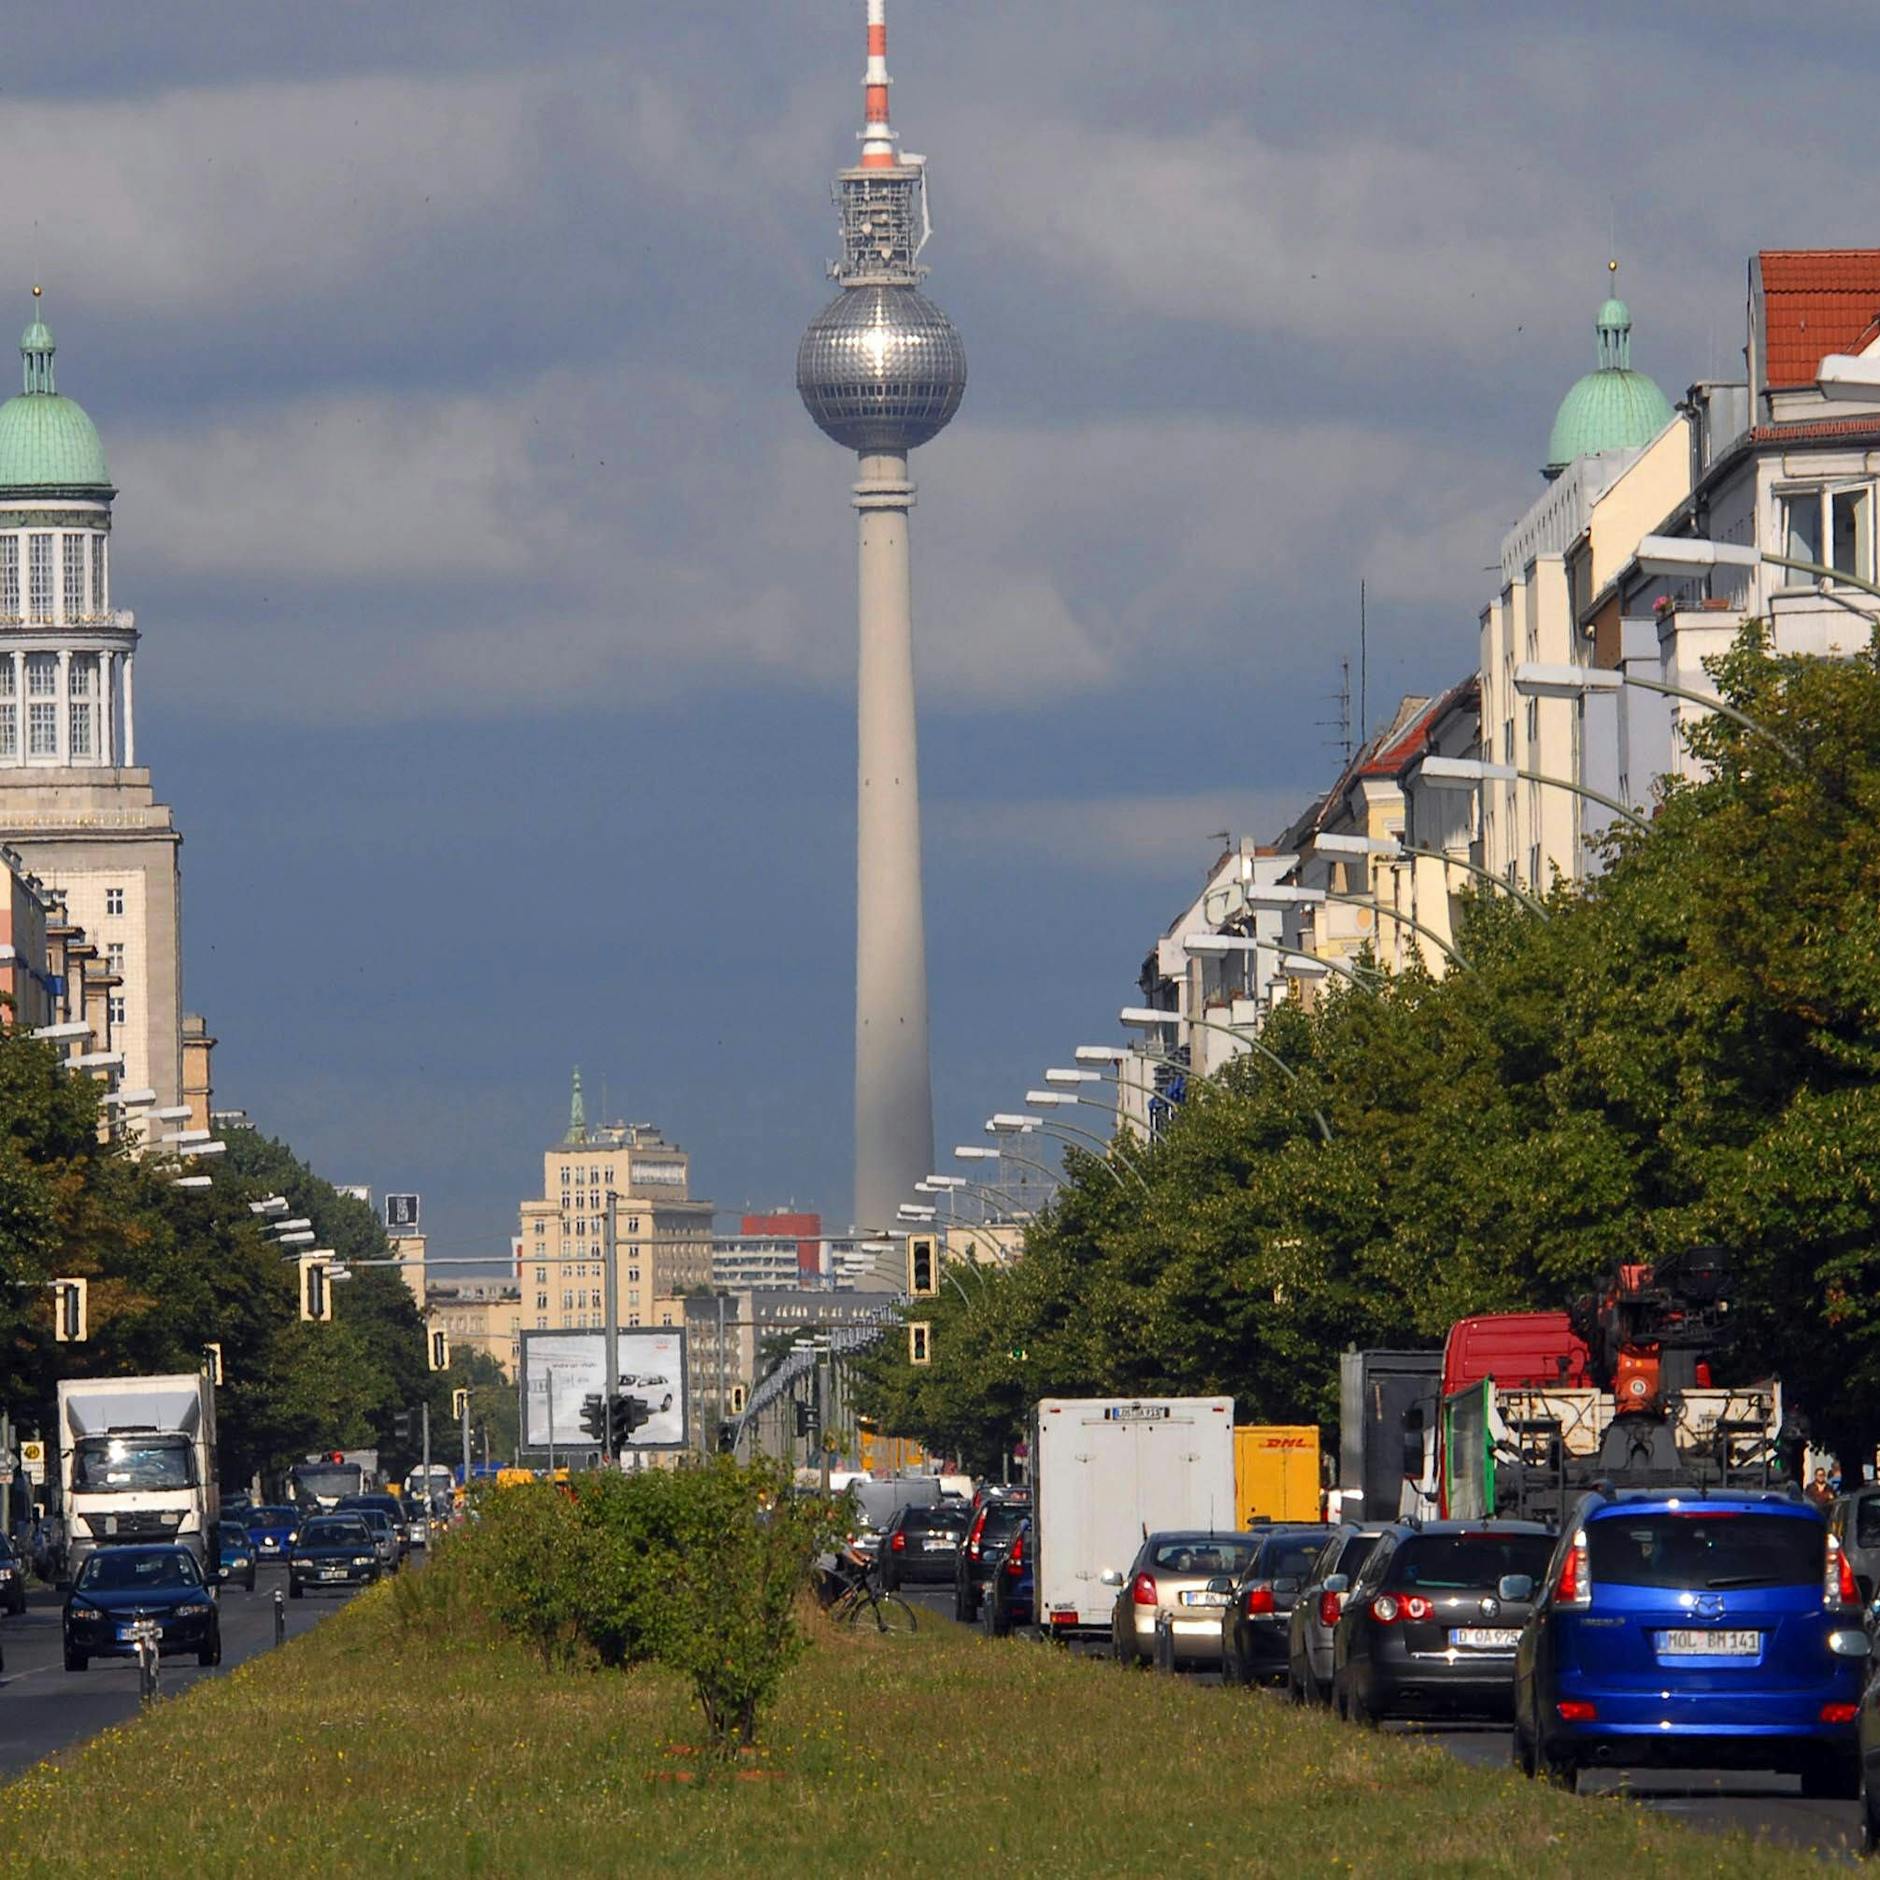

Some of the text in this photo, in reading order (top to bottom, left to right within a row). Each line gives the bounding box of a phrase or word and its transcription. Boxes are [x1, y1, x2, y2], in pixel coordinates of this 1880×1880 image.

[1266, 1438, 1306, 1448] DHL
[1667, 1632, 1697, 1649] MOL
[1729, 1632, 1757, 1649] 141
